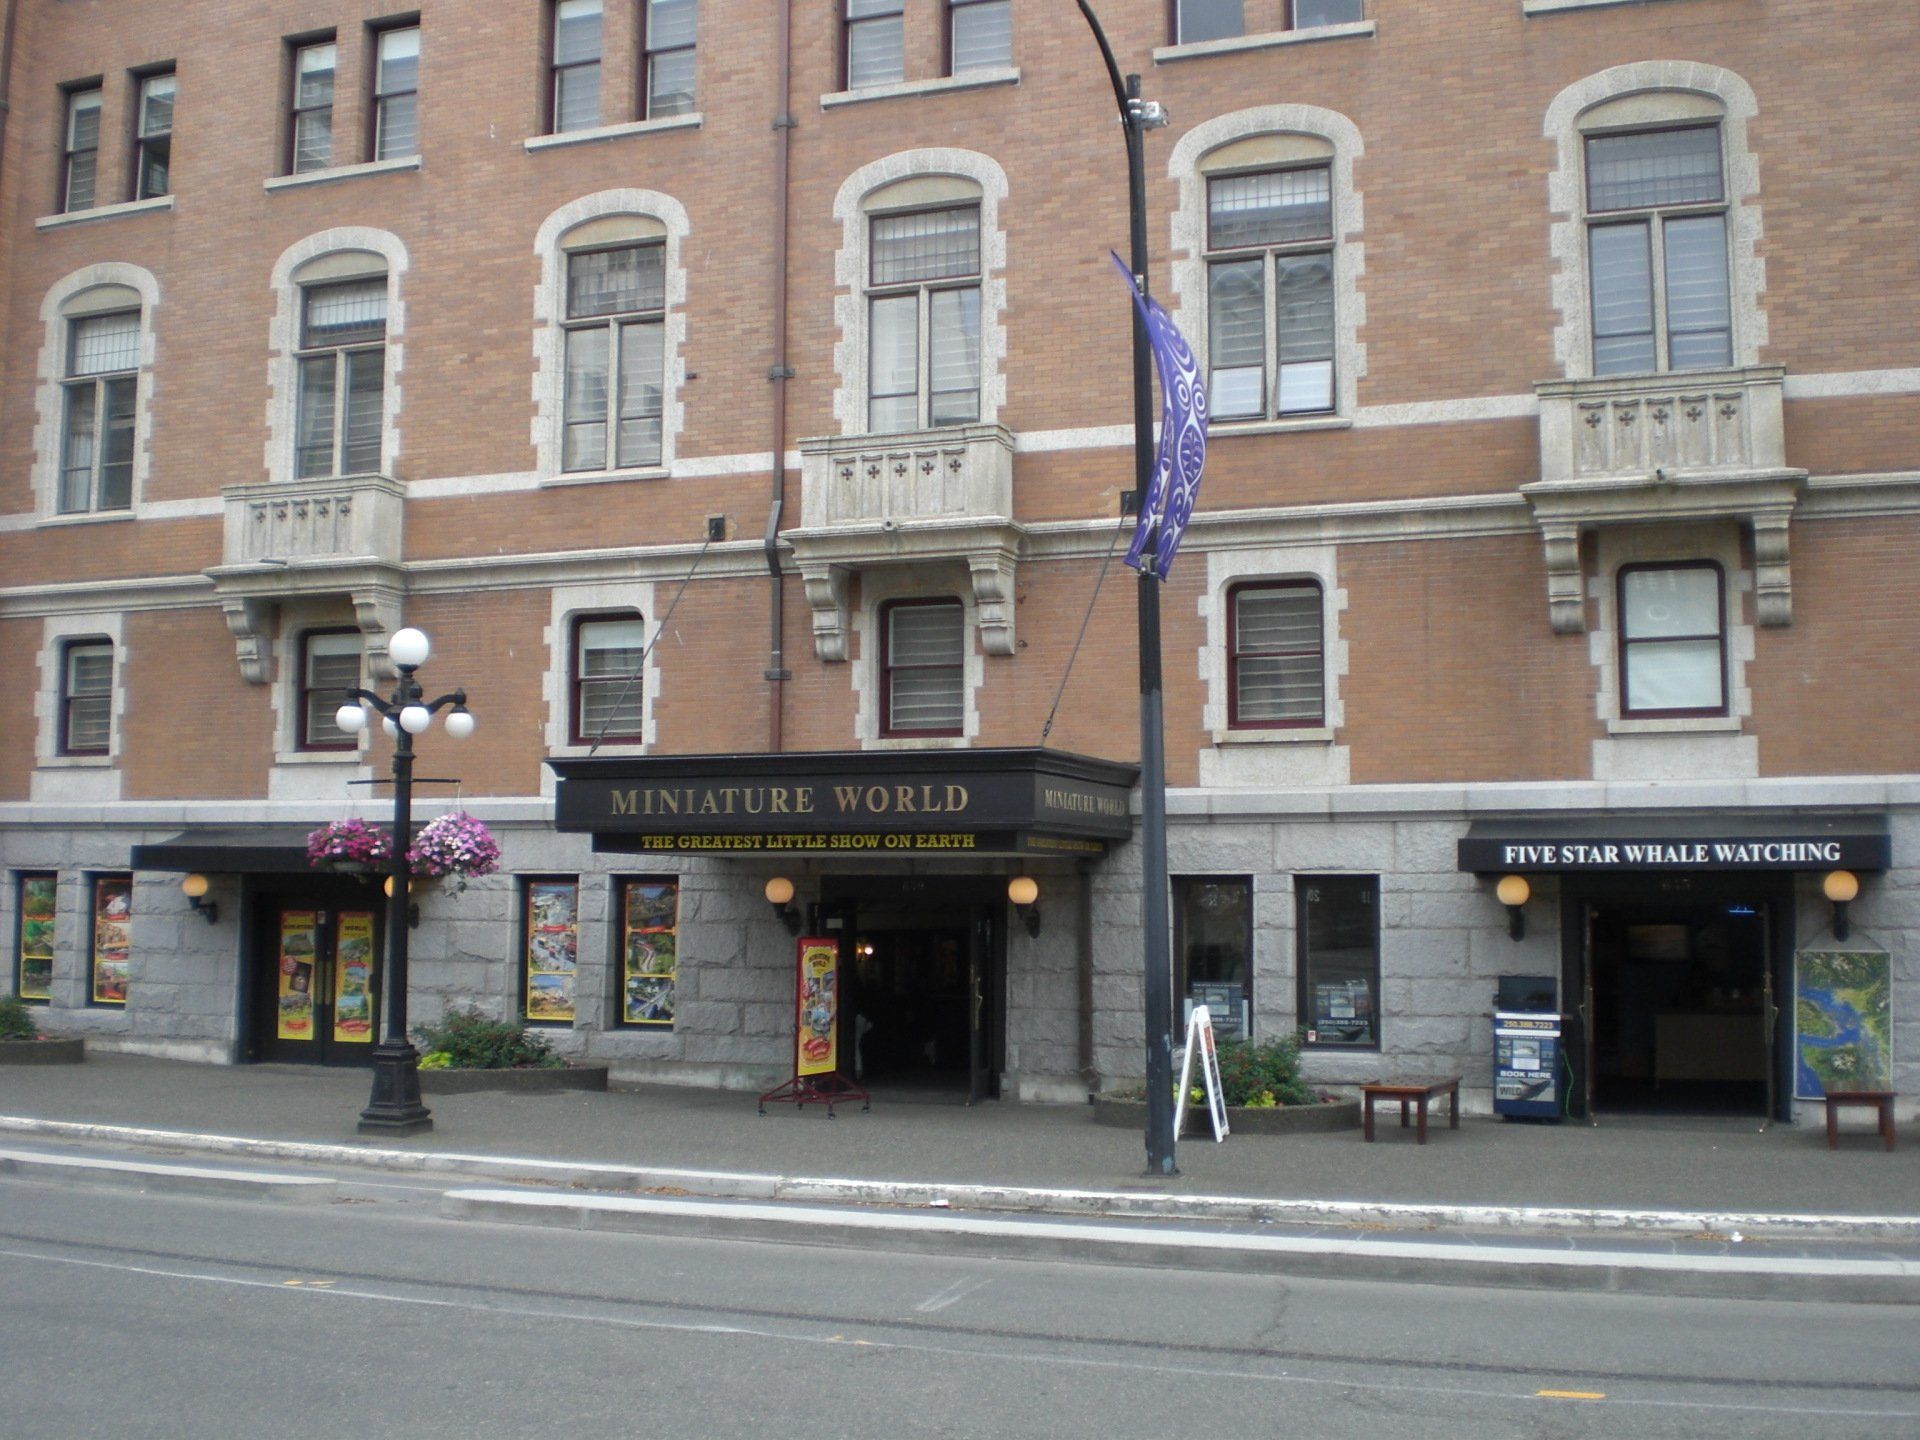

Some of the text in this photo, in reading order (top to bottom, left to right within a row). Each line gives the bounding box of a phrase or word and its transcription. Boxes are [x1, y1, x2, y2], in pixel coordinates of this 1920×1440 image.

[610, 785, 969, 815] MINIATURE WORLD
[642, 834, 975, 849] THE GREATEST LITTLE SHOW ON EARTH
[1504, 842, 1841, 863] FIVE STAR WHALE WATCHING
